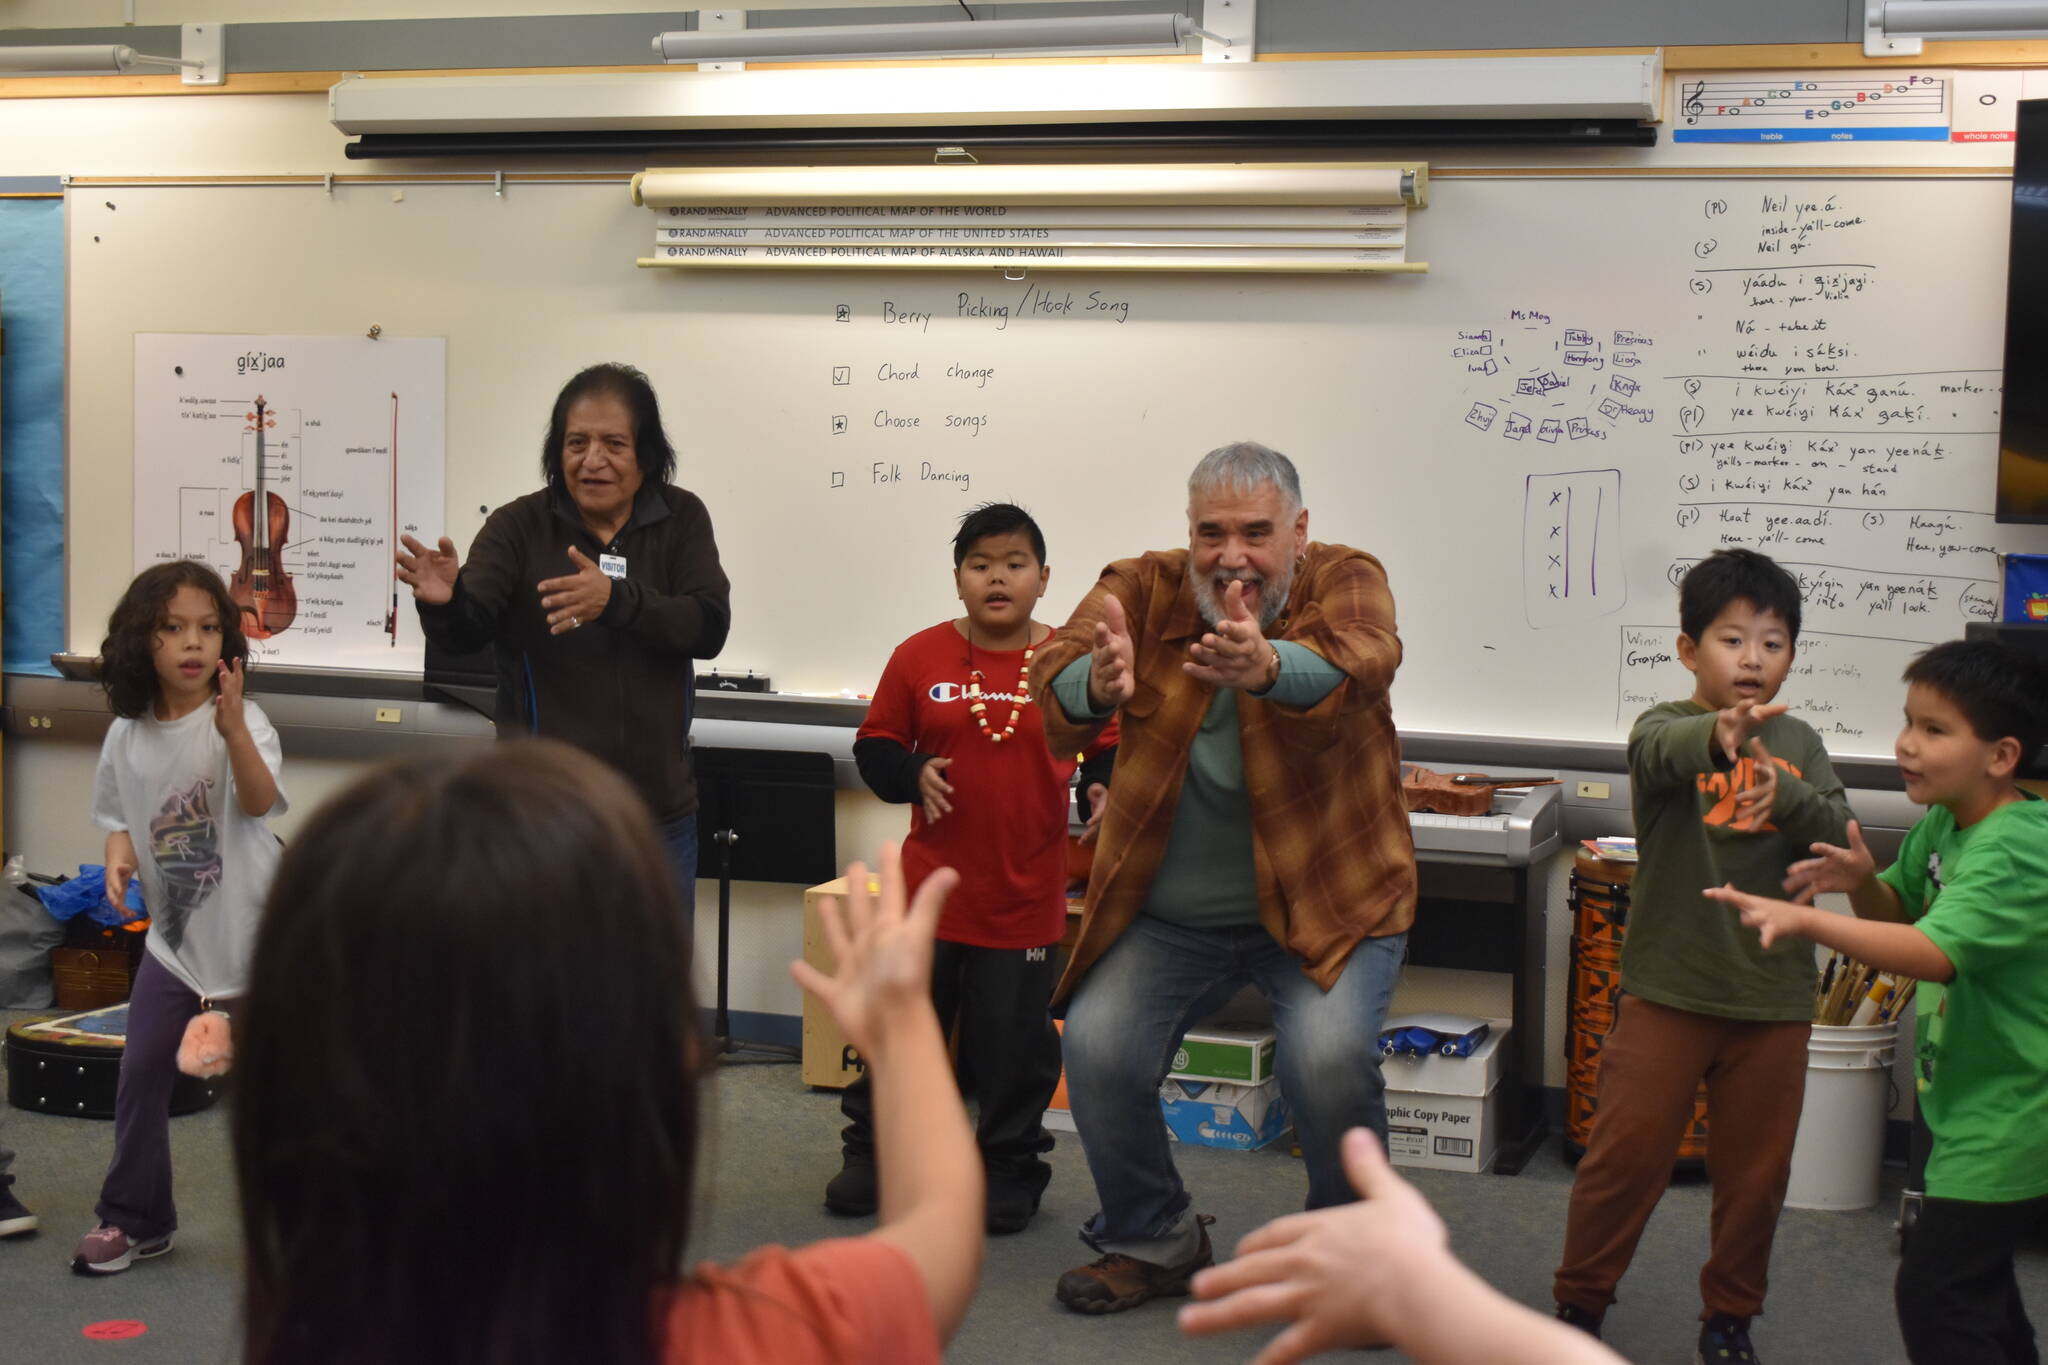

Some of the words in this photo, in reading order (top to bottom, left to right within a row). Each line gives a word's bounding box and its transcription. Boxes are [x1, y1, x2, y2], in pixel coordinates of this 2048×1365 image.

[1718, 106, 1725, 116] F
[1742, 98, 1750, 106] A
[1795, 81, 1803, 91] E
[1805, 110, 1813, 119] E
[1831, 101, 1841, 110] G
[1857, 93, 1866, 102] B
[1909, 76, 1917, 85] F
[1964, 132, 1987, 140] whole
[1990, 132, 2008, 140] note
[1762, 195, 1787, 213] Neil
[765, 207, 826, 216] ADVANCED
[831, 207, 886, 216] POLITICAL
[891, 207, 915, 216] MAP
[920, 207, 934, 216] OF
[939, 207, 959, 216] THE
[964, 207, 1006, 216] WORLD
[765, 229, 825, 238] ADVANCED
[830, 229, 884, 238] POLITICAL
[890, 229, 914, 238] MAP
[919, 229, 933, 238] OF
[939, 229, 958, 238] THE
[963, 229, 1004, 238] UNITED
[1010, 229, 1048, 238] STATES
[765, 248, 826, 256] ADVANCED
[831, 248, 886, 257] POLITICAL
[891, 248, 916, 257] MAP
[921, 248, 935, 257] OF
[940, 248, 984, 257] ALASKA
[989, 248, 1014, 257] AND
[1020, 248, 1063, 257] HAWAII
[1758, 239, 1780, 253] Neil
[884, 302, 931, 333] Berry
[1086, 291, 1129, 323] Song
[1511, 310, 1525, 320] Ms
[878, 362, 919, 380] Chord
[947, 362, 994, 388] change
[1730, 407, 1754, 421] yee
[874, 410, 920, 428] Choose
[945, 414, 987, 437] songs
[1711, 442, 1735, 458] yee
[1862, 464, 1898, 473] stand
[873, 463, 901, 484] Folk
[921, 462, 970, 491] Dancing
[602, 562, 625, 573] VISITOR
[1627, 651, 1671, 669] Grayson
[1026, 948, 1046, 961] HH
[1414, 1109, 1439, 1122] Copy
[1442, 1112, 1471, 1124] Paper
